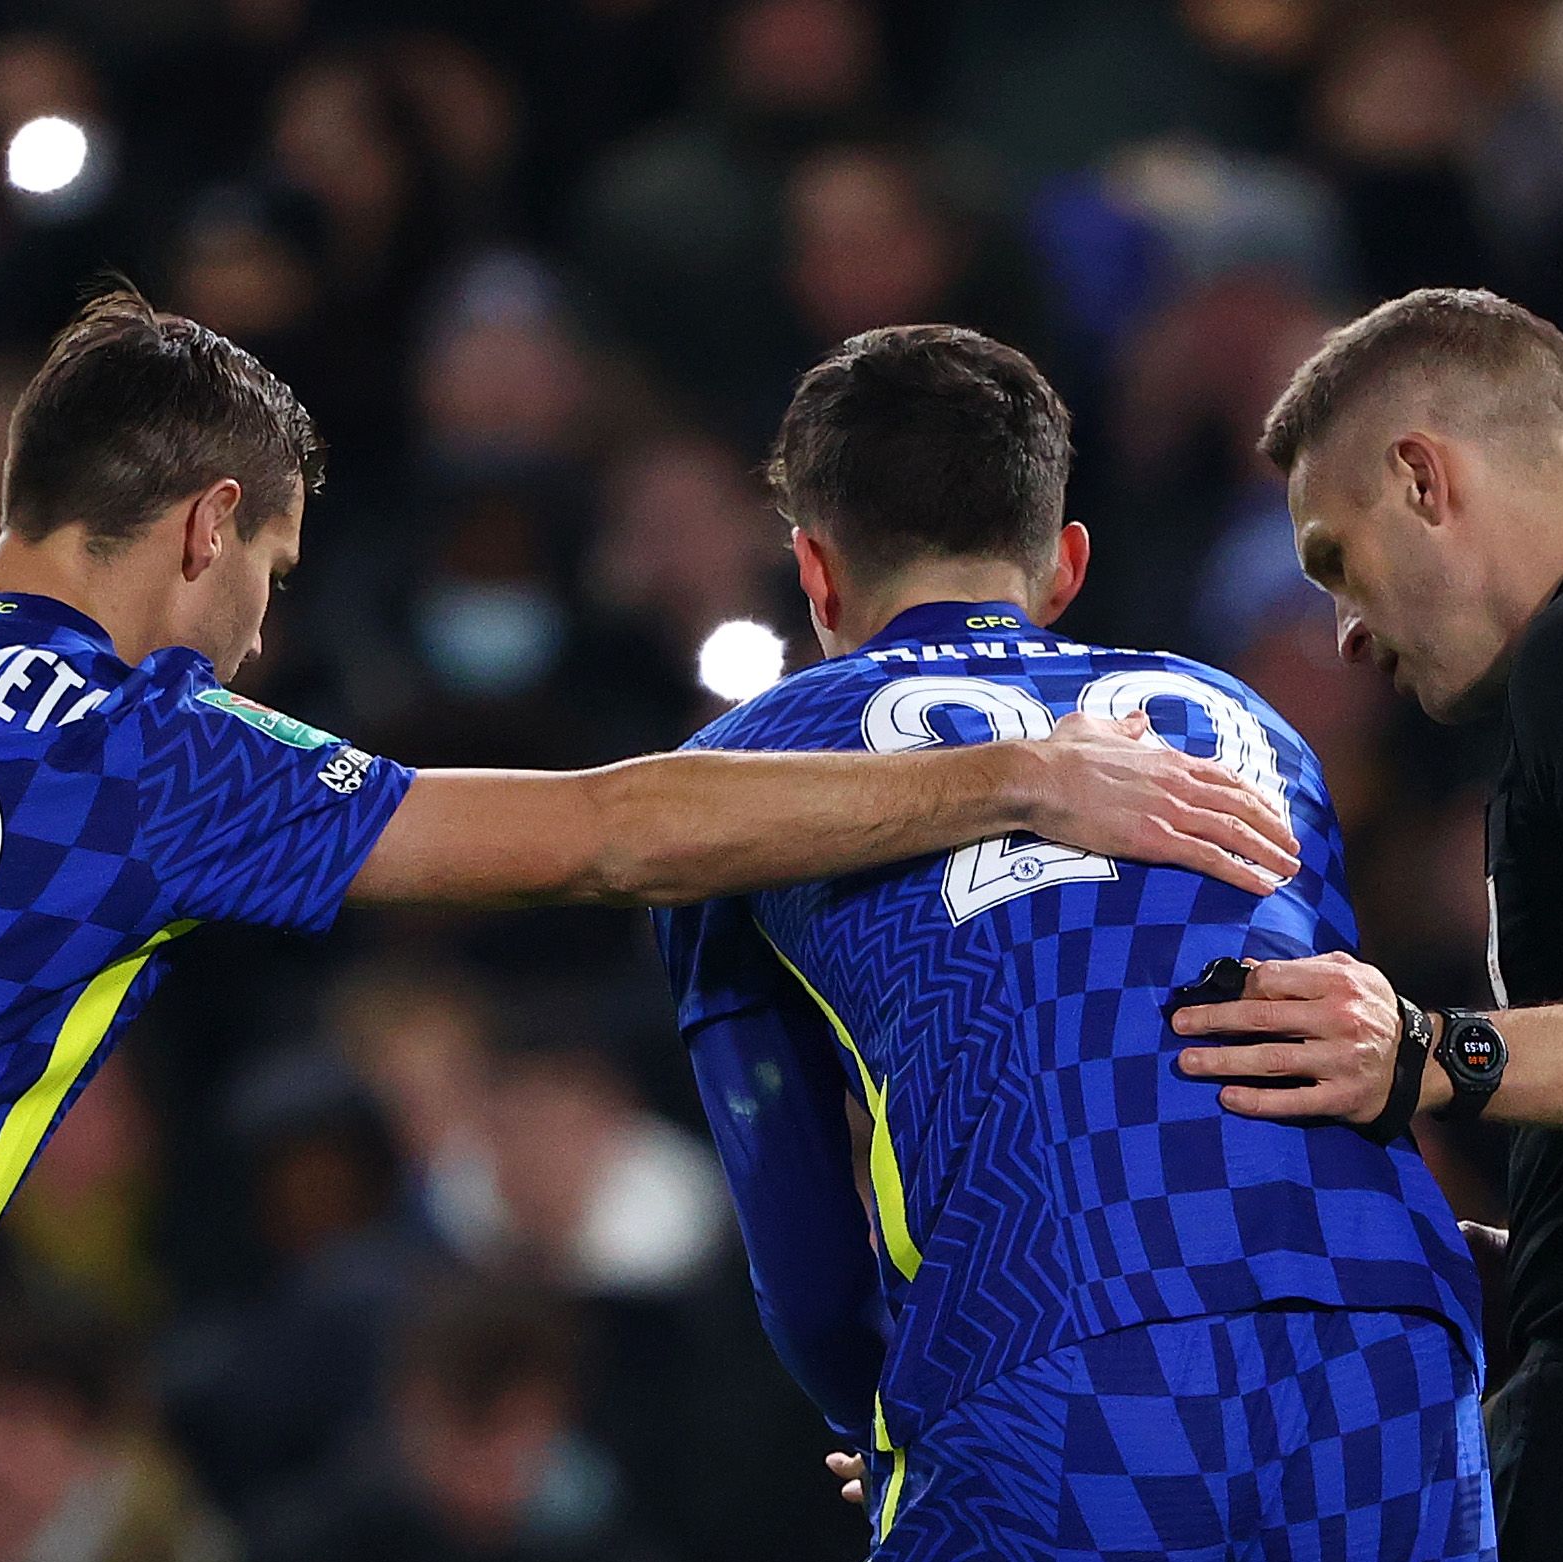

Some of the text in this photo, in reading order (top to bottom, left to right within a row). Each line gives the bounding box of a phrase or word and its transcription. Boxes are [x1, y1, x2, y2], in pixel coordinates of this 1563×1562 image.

[965, 616, 1021, 629] CFC
[317, 759, 353, 790] No
[1464, 1041, 1491, 1053] 04:53
